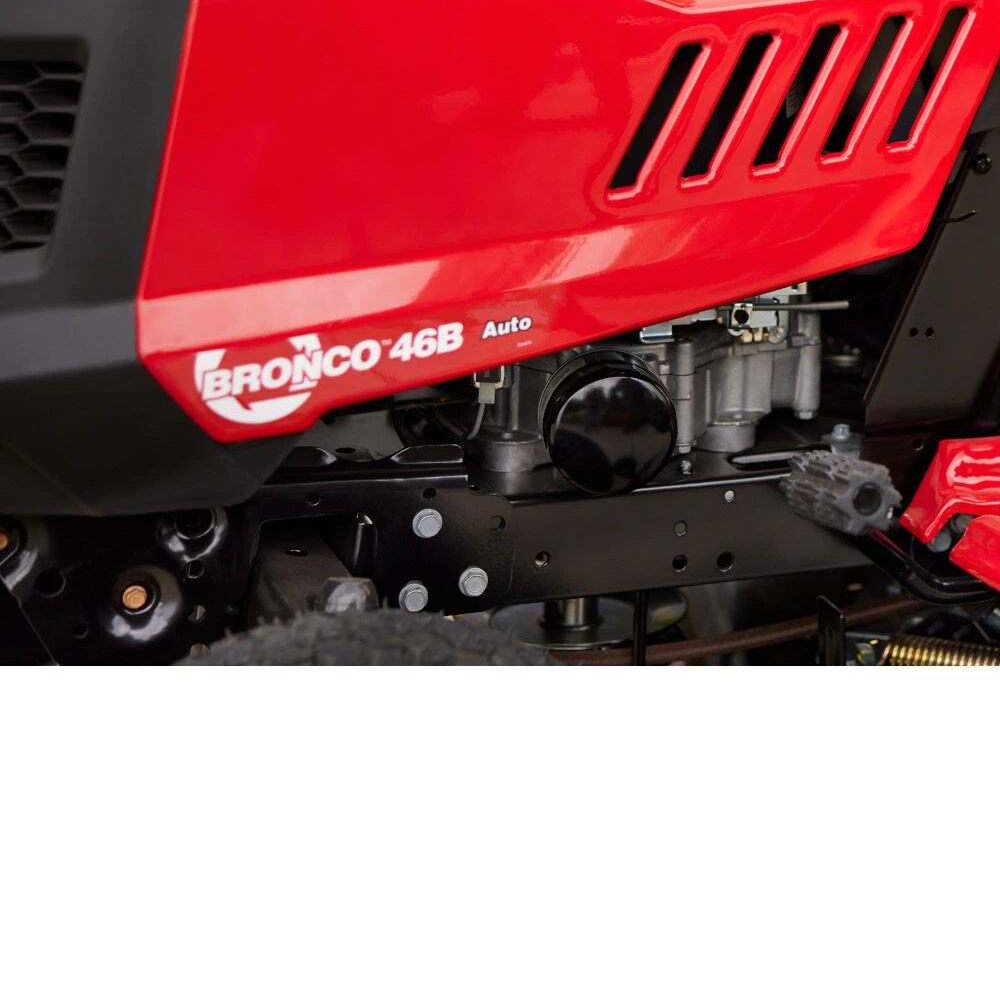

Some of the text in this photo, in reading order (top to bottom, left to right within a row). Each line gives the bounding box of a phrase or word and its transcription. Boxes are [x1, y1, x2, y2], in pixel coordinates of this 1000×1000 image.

[481, 316, 532, 339] Auto
[201, 322, 464, 400] BRONCO 46B
